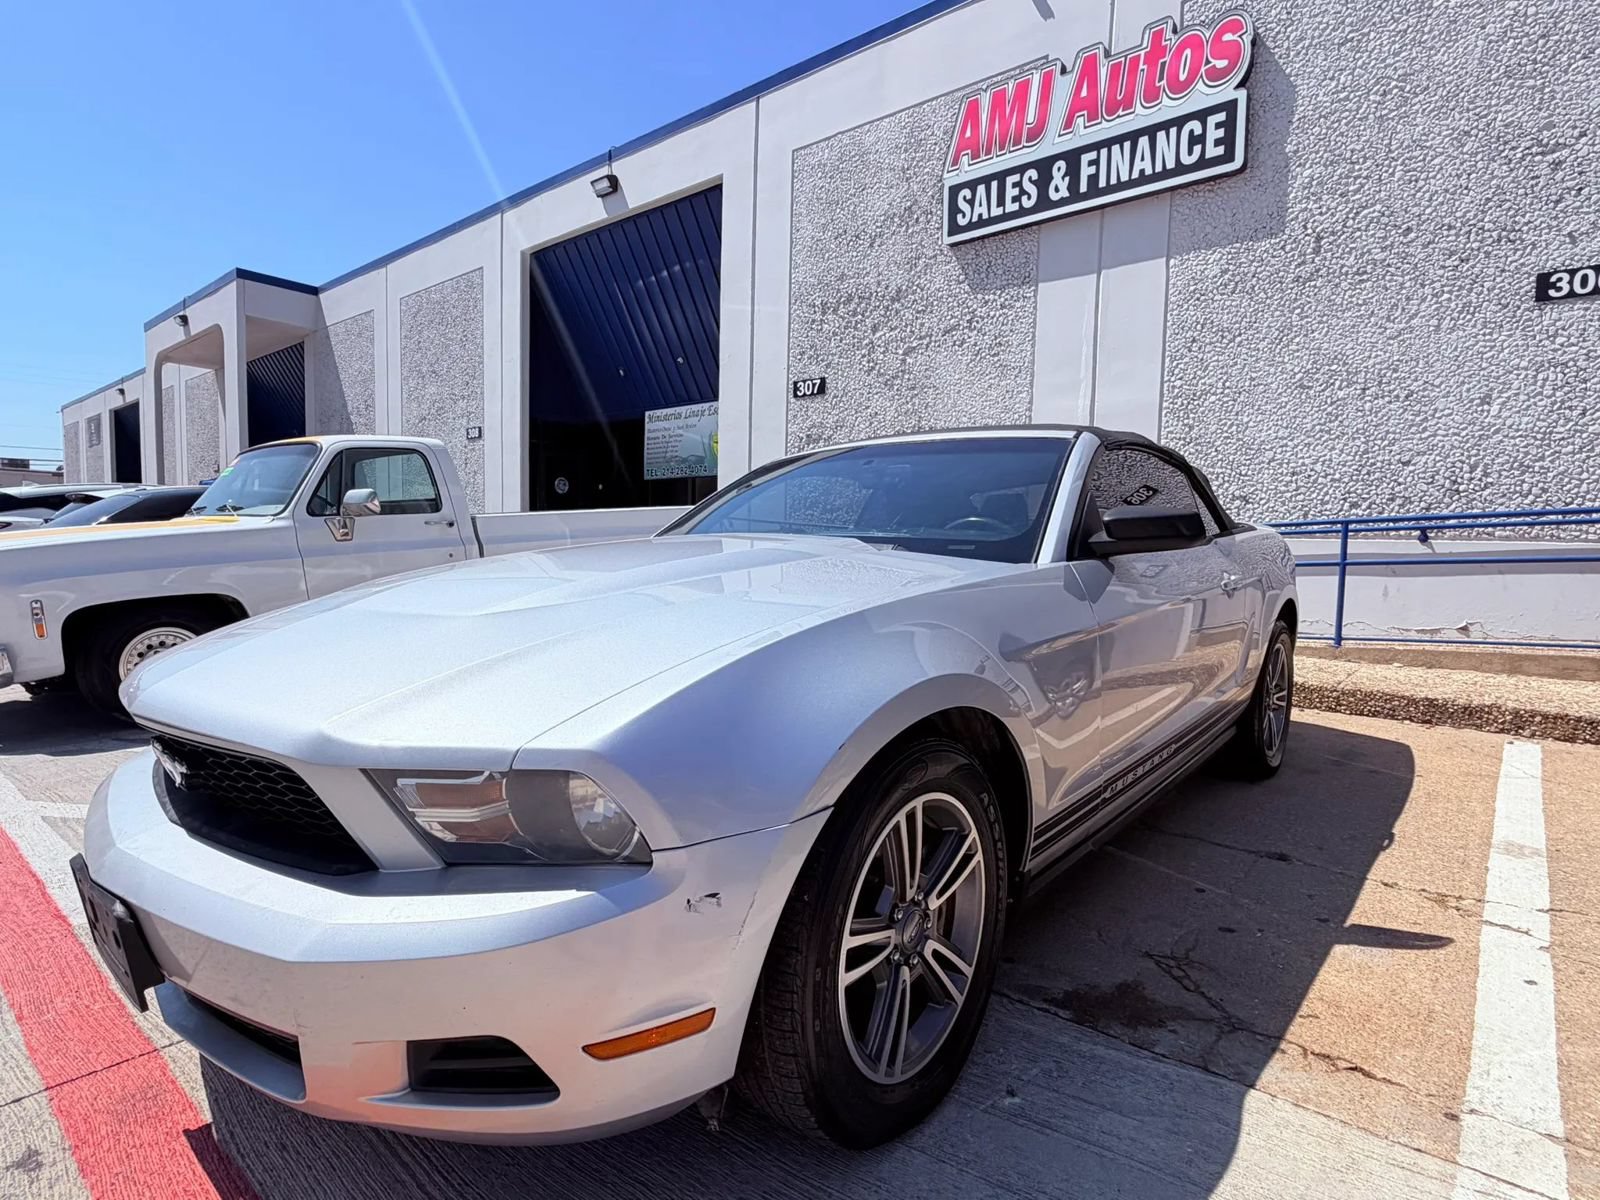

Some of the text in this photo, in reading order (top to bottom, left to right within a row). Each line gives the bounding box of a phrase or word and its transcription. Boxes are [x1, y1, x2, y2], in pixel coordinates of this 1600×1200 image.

[950, 16, 1249, 171] AMJ Autos
[957, 111, 1227, 226] SALES & FINANCE
[1548, 268, 1600, 298] 30
[796, 380, 821, 396] 307
[1109, 746, 1174, 795] MUSTANG
